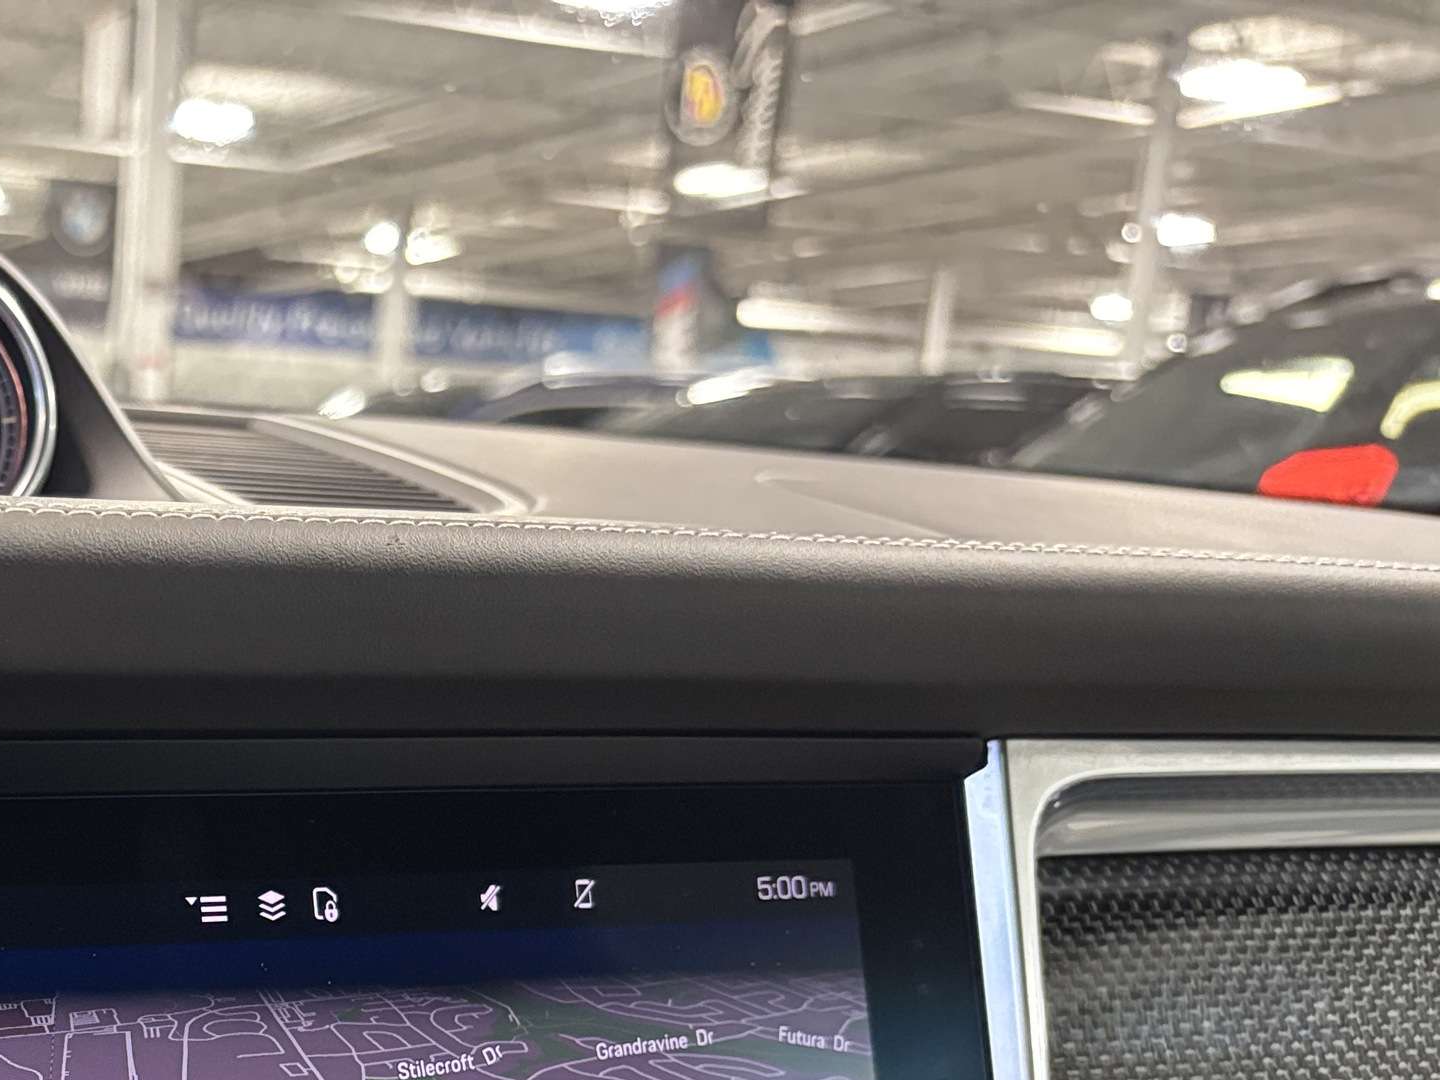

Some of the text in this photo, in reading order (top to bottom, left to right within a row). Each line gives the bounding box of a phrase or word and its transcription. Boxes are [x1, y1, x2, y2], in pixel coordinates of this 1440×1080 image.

[757, 875, 835, 900] 5:00 PM
[596, 1028, 714, 1060] Grandravine Dr
[778, 1026, 851, 1052] Futura Dr
[397, 1044, 503, 1080] Stilecroft Dr
